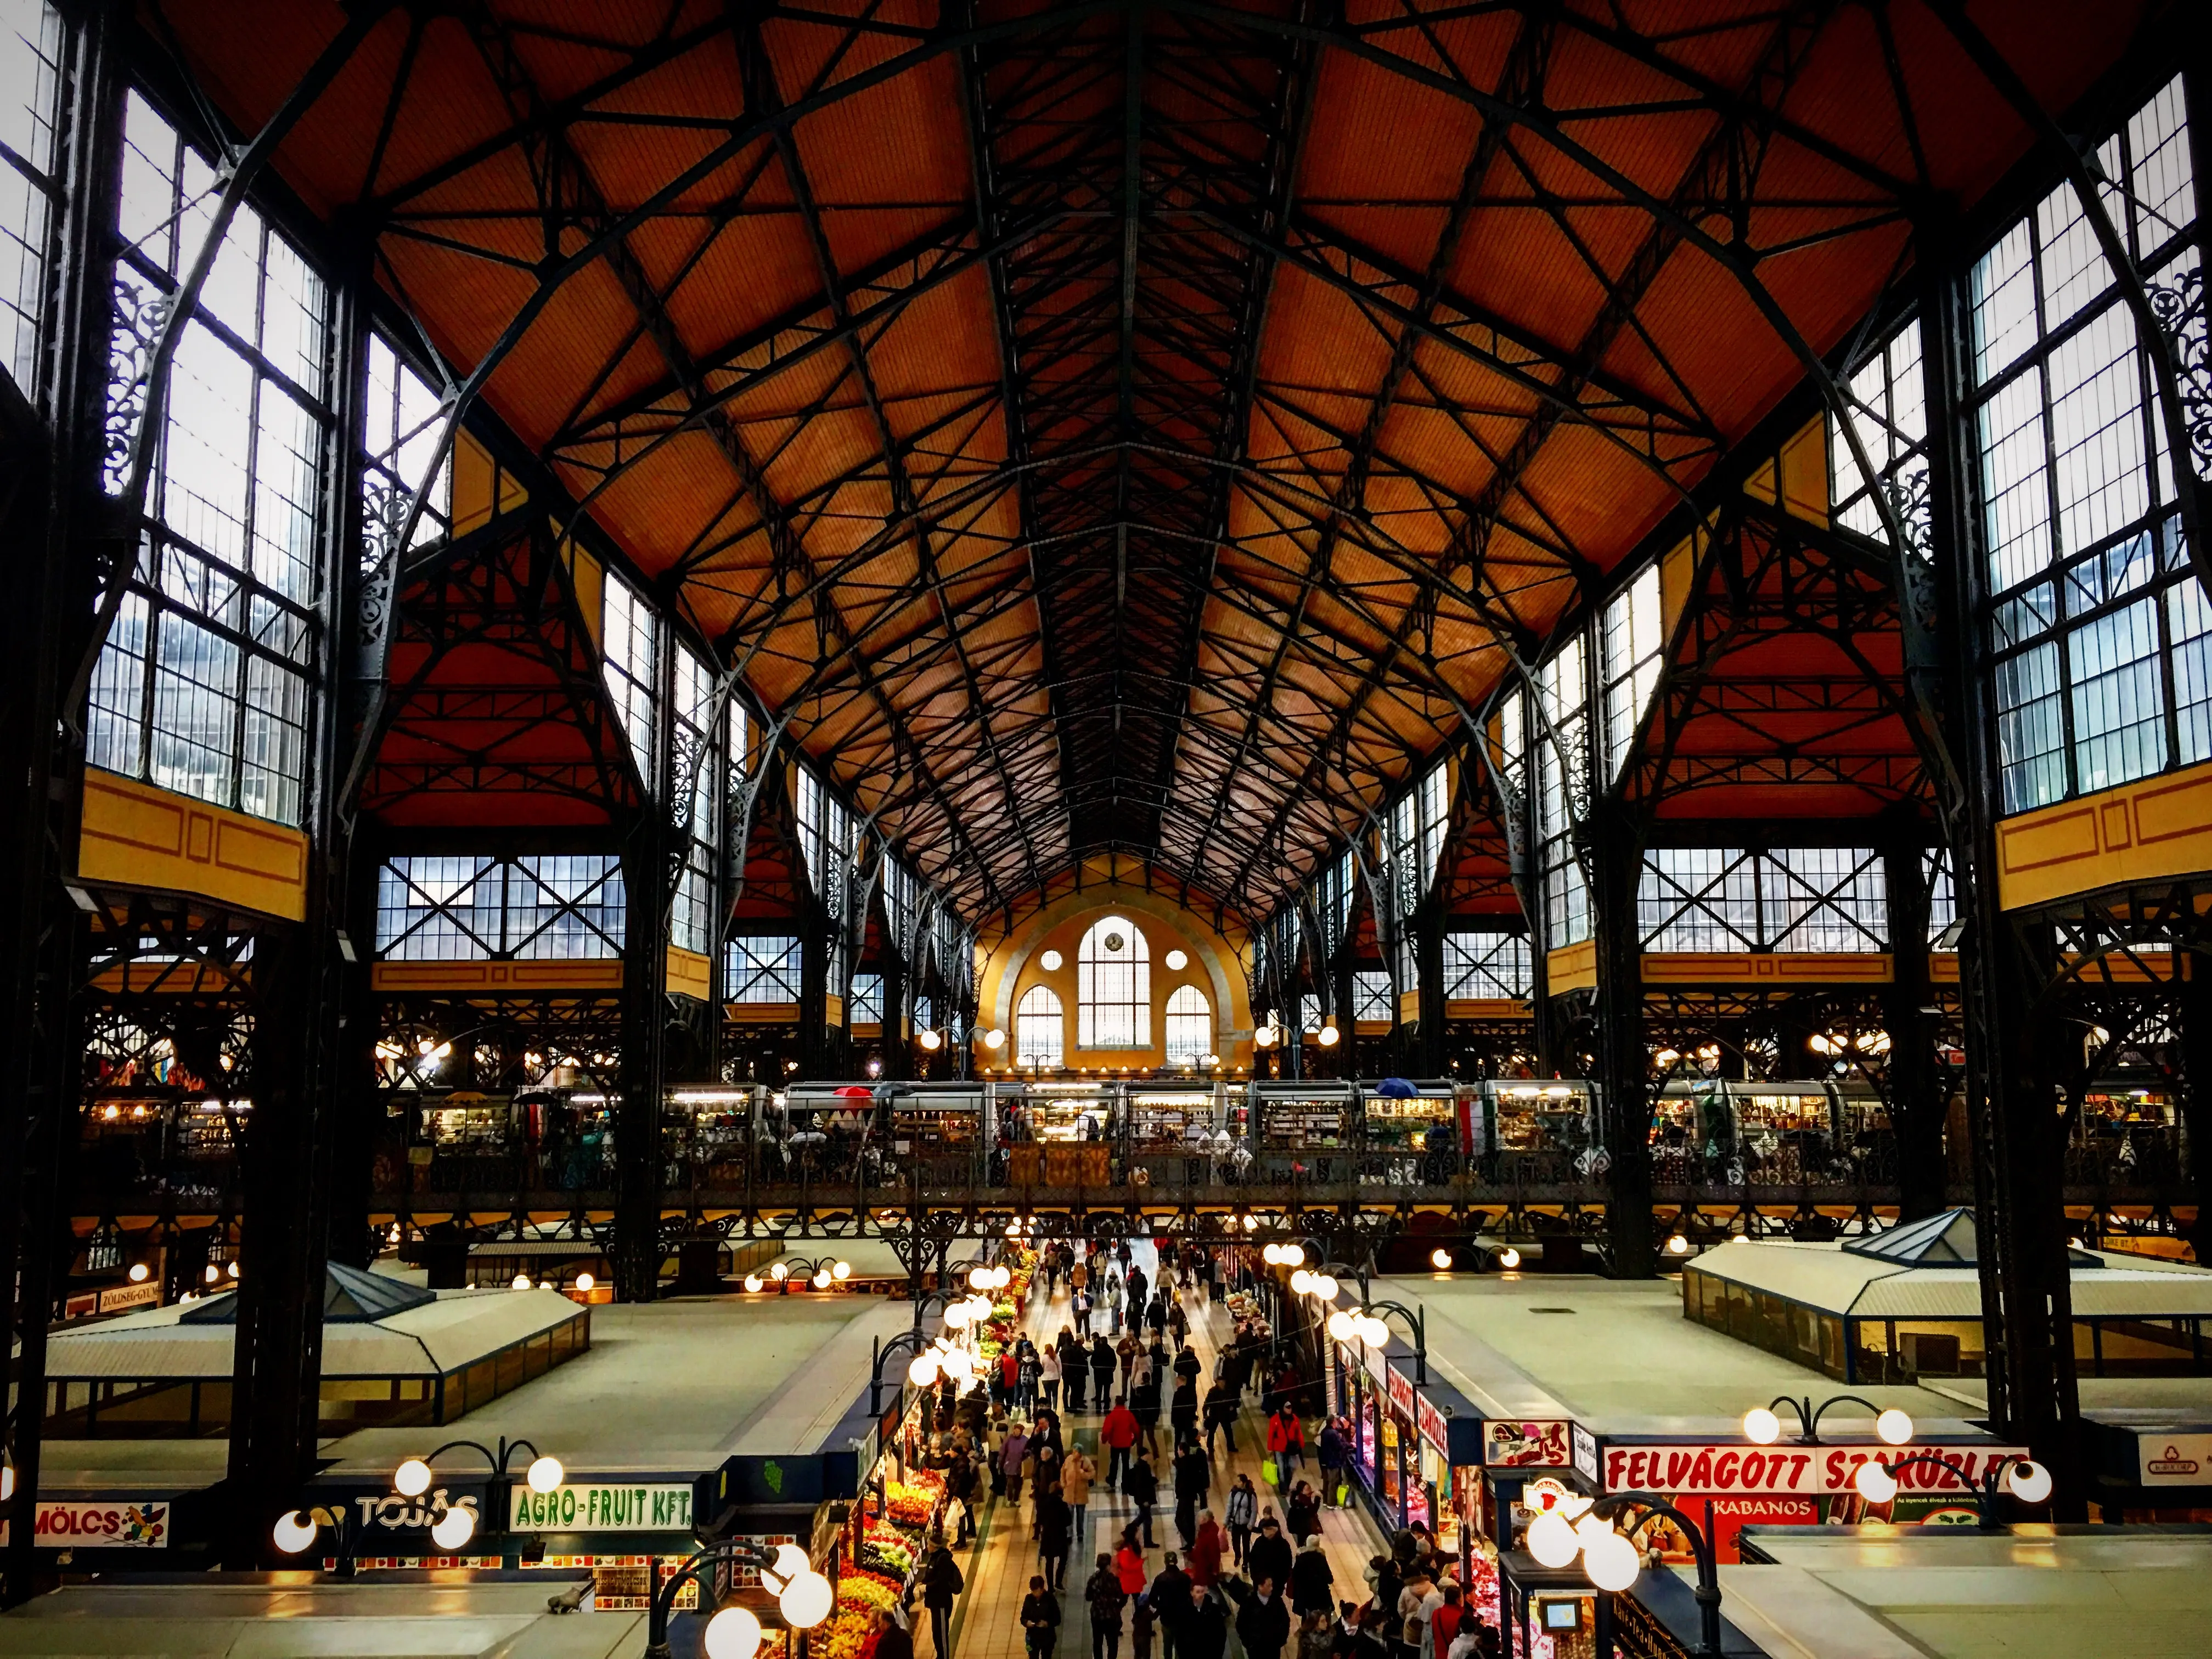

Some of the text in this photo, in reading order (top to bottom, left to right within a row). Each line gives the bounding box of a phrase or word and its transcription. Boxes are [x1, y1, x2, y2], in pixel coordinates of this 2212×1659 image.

[1607, 1447, 1811, 1489] FELVÁGOTT
[515, 1488, 691, 1527] AGRO-FRUIT KFT.
[1713, 1500, 1811, 1515] KABANOS
